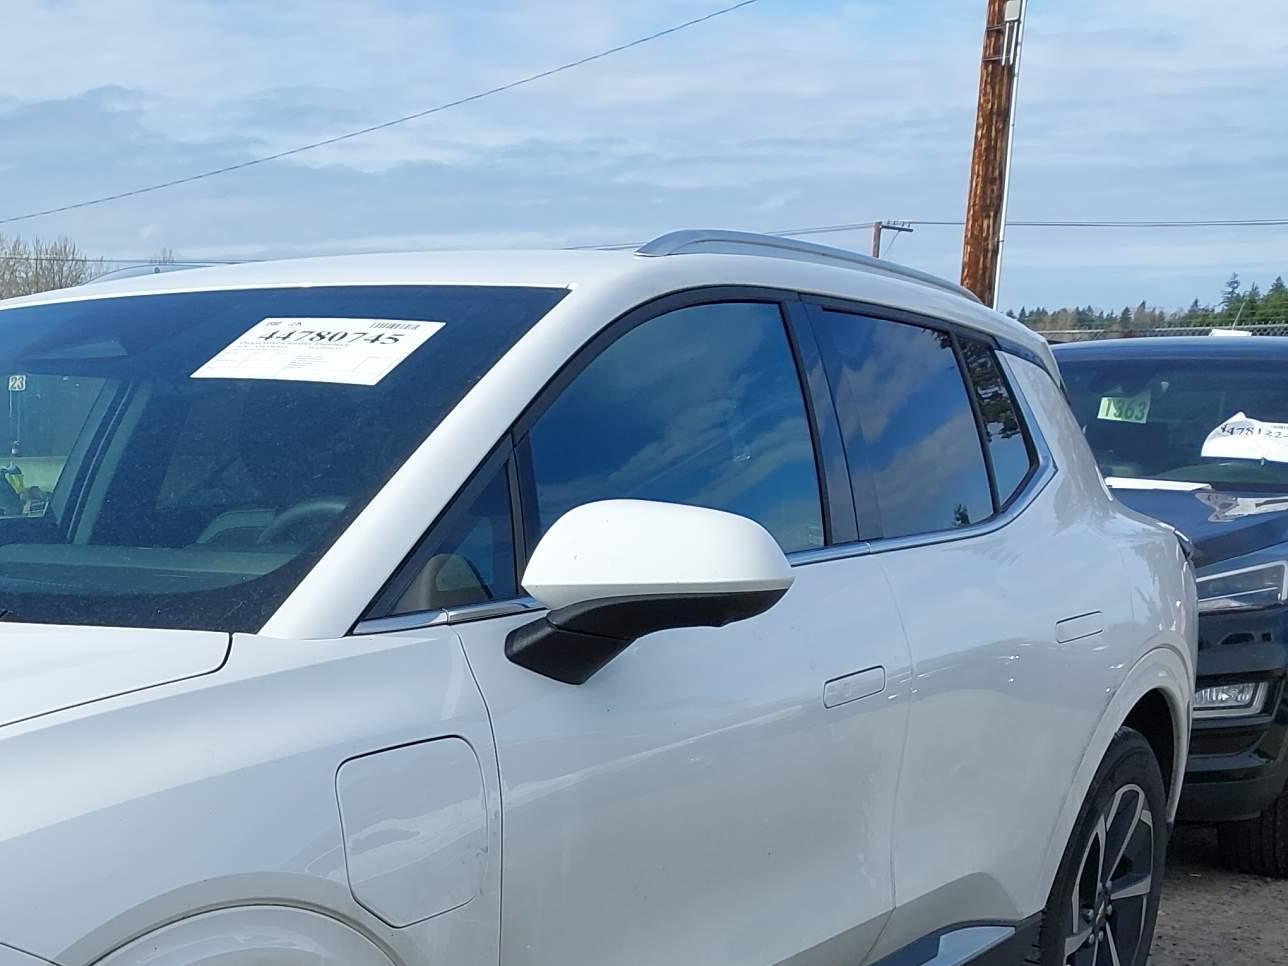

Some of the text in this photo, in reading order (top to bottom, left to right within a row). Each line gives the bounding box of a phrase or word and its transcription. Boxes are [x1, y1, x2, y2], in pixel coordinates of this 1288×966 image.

[257, 329, 407, 345] 44780745
[10, 376, 25, 390] 23
[1103, 398, 1147, 421] 1363
